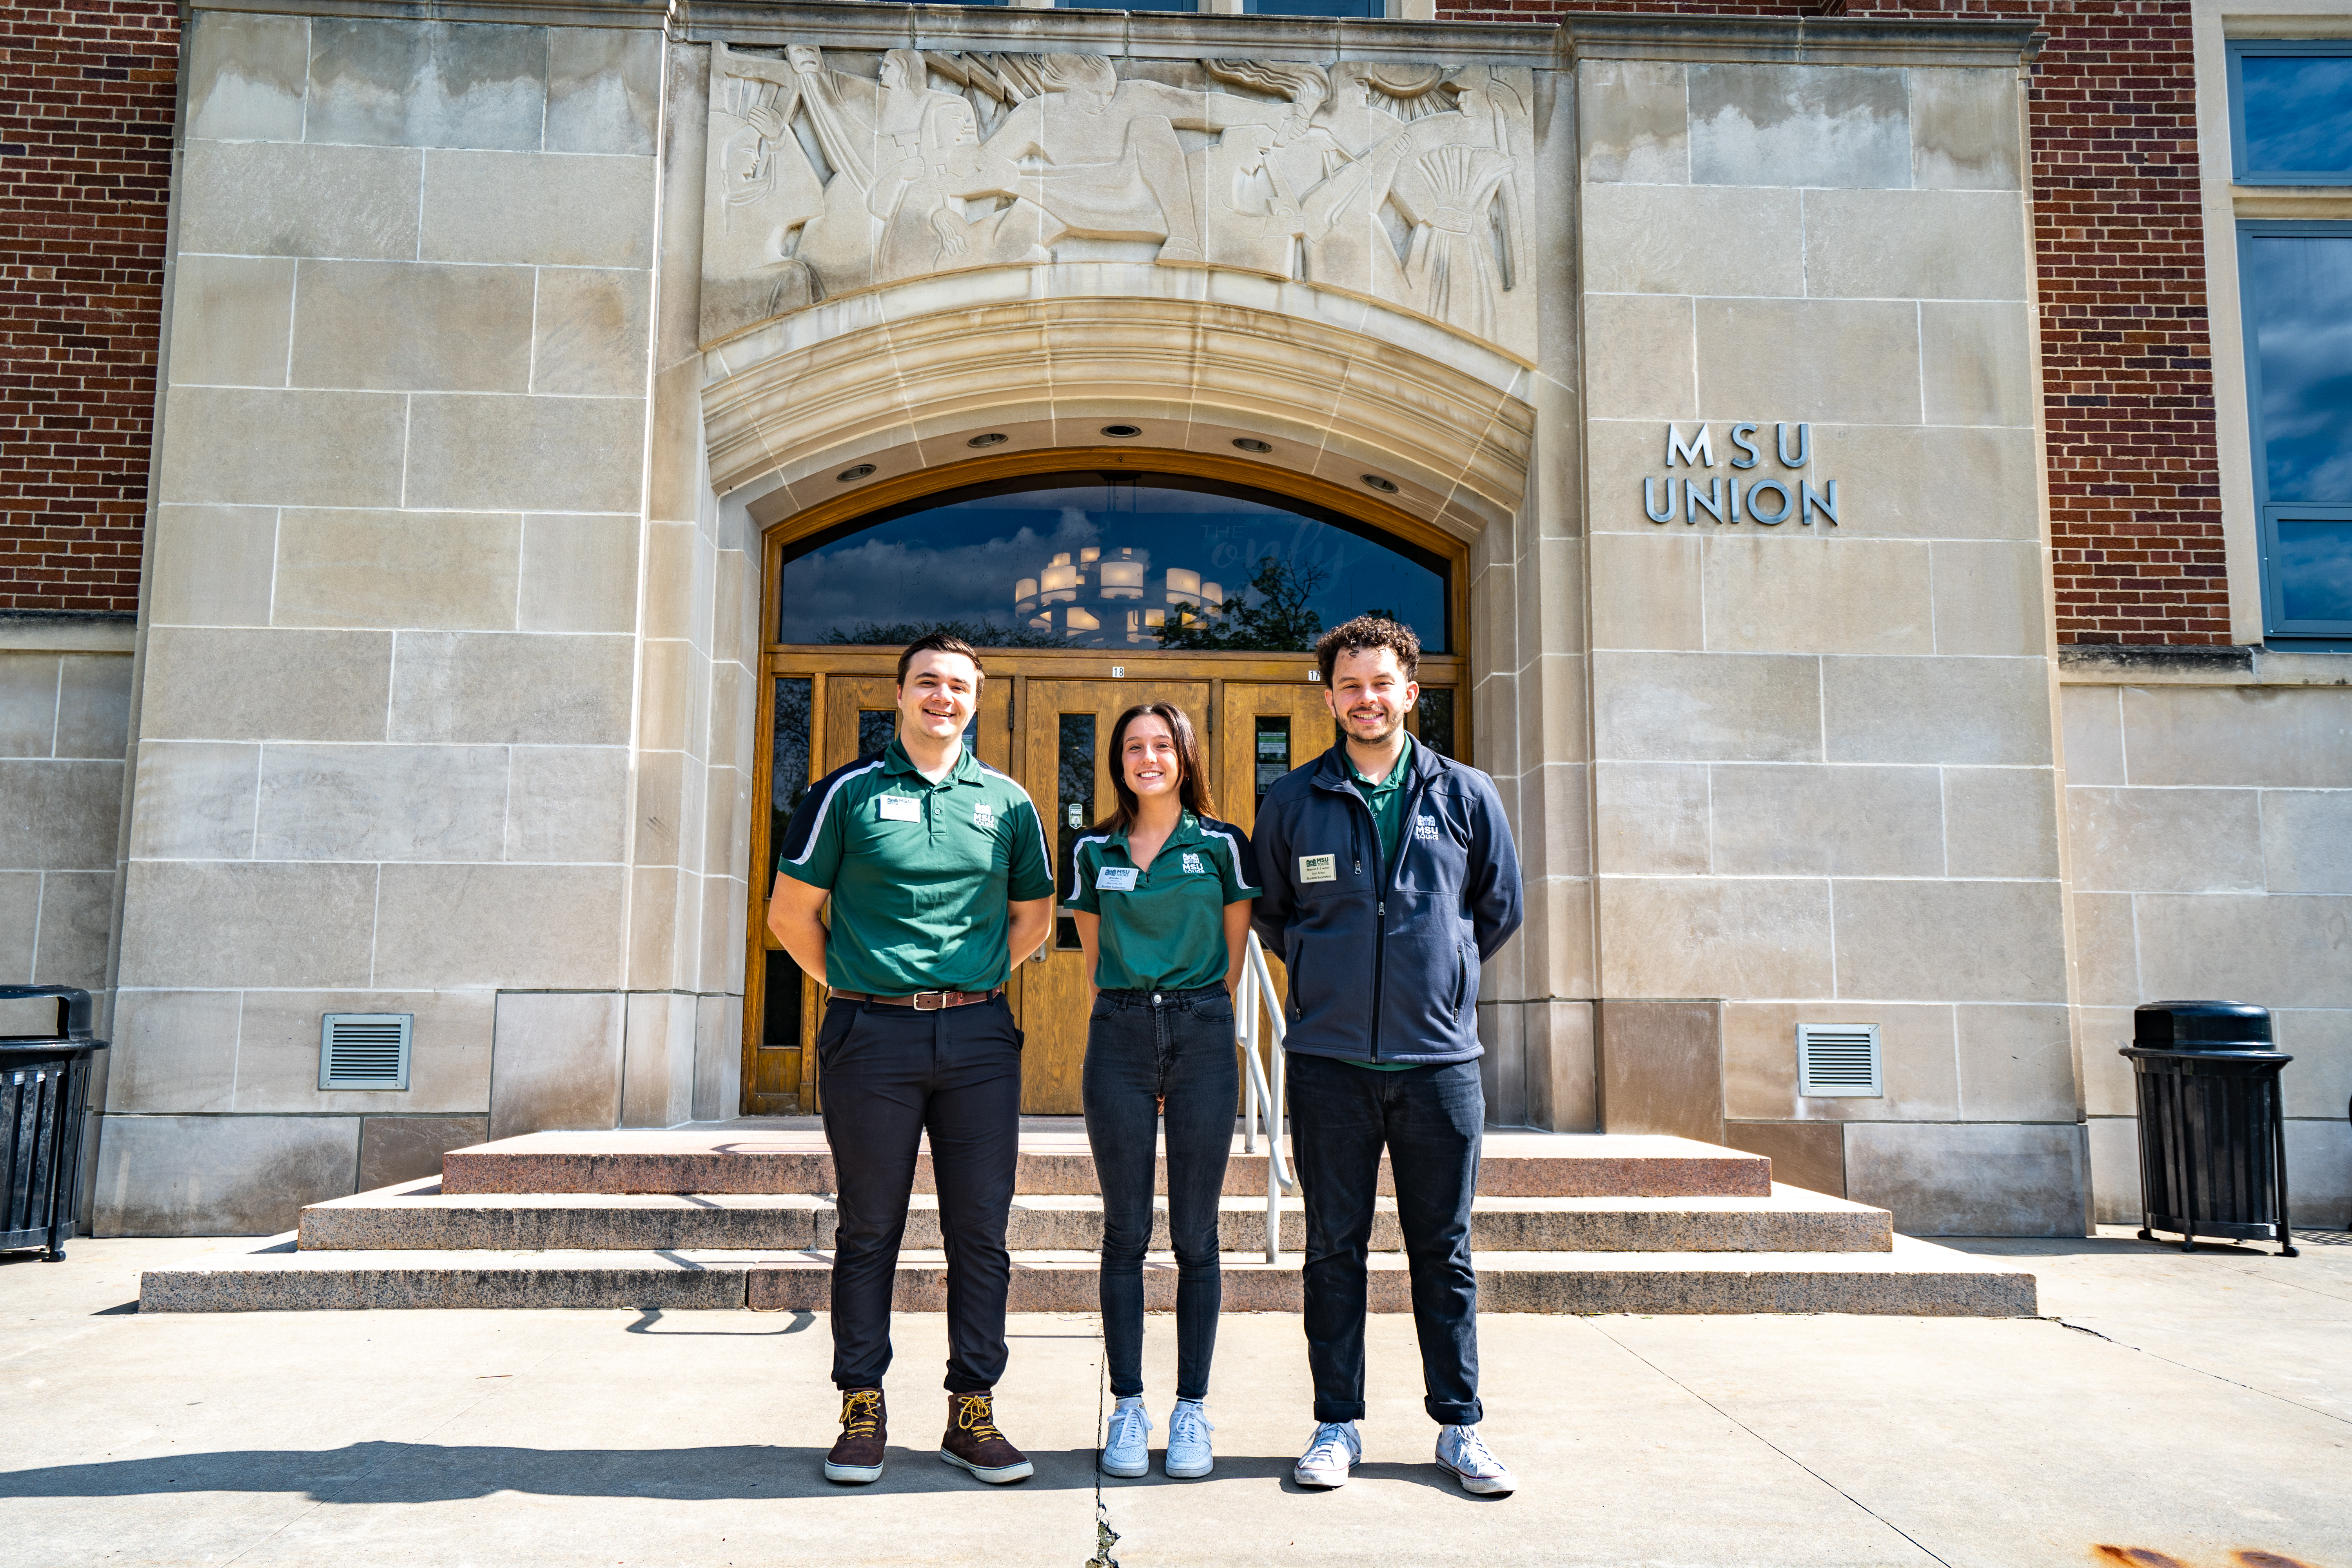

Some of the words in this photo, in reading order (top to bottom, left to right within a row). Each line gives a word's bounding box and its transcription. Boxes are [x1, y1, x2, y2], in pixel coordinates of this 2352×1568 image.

[1666, 423, 1809, 468] MSU
[1644, 477, 1838, 526] UNION
[1200, 524, 1245, 539] THE
[1211, 516, 1364, 596] only
[1114, 668, 1123, 677] 18
[1310, 671, 1319, 680] 17
[973, 813, 994, 823] MSU
[973, 820, 995, 828] TOURS
[1416, 826, 1438, 835] MSU
